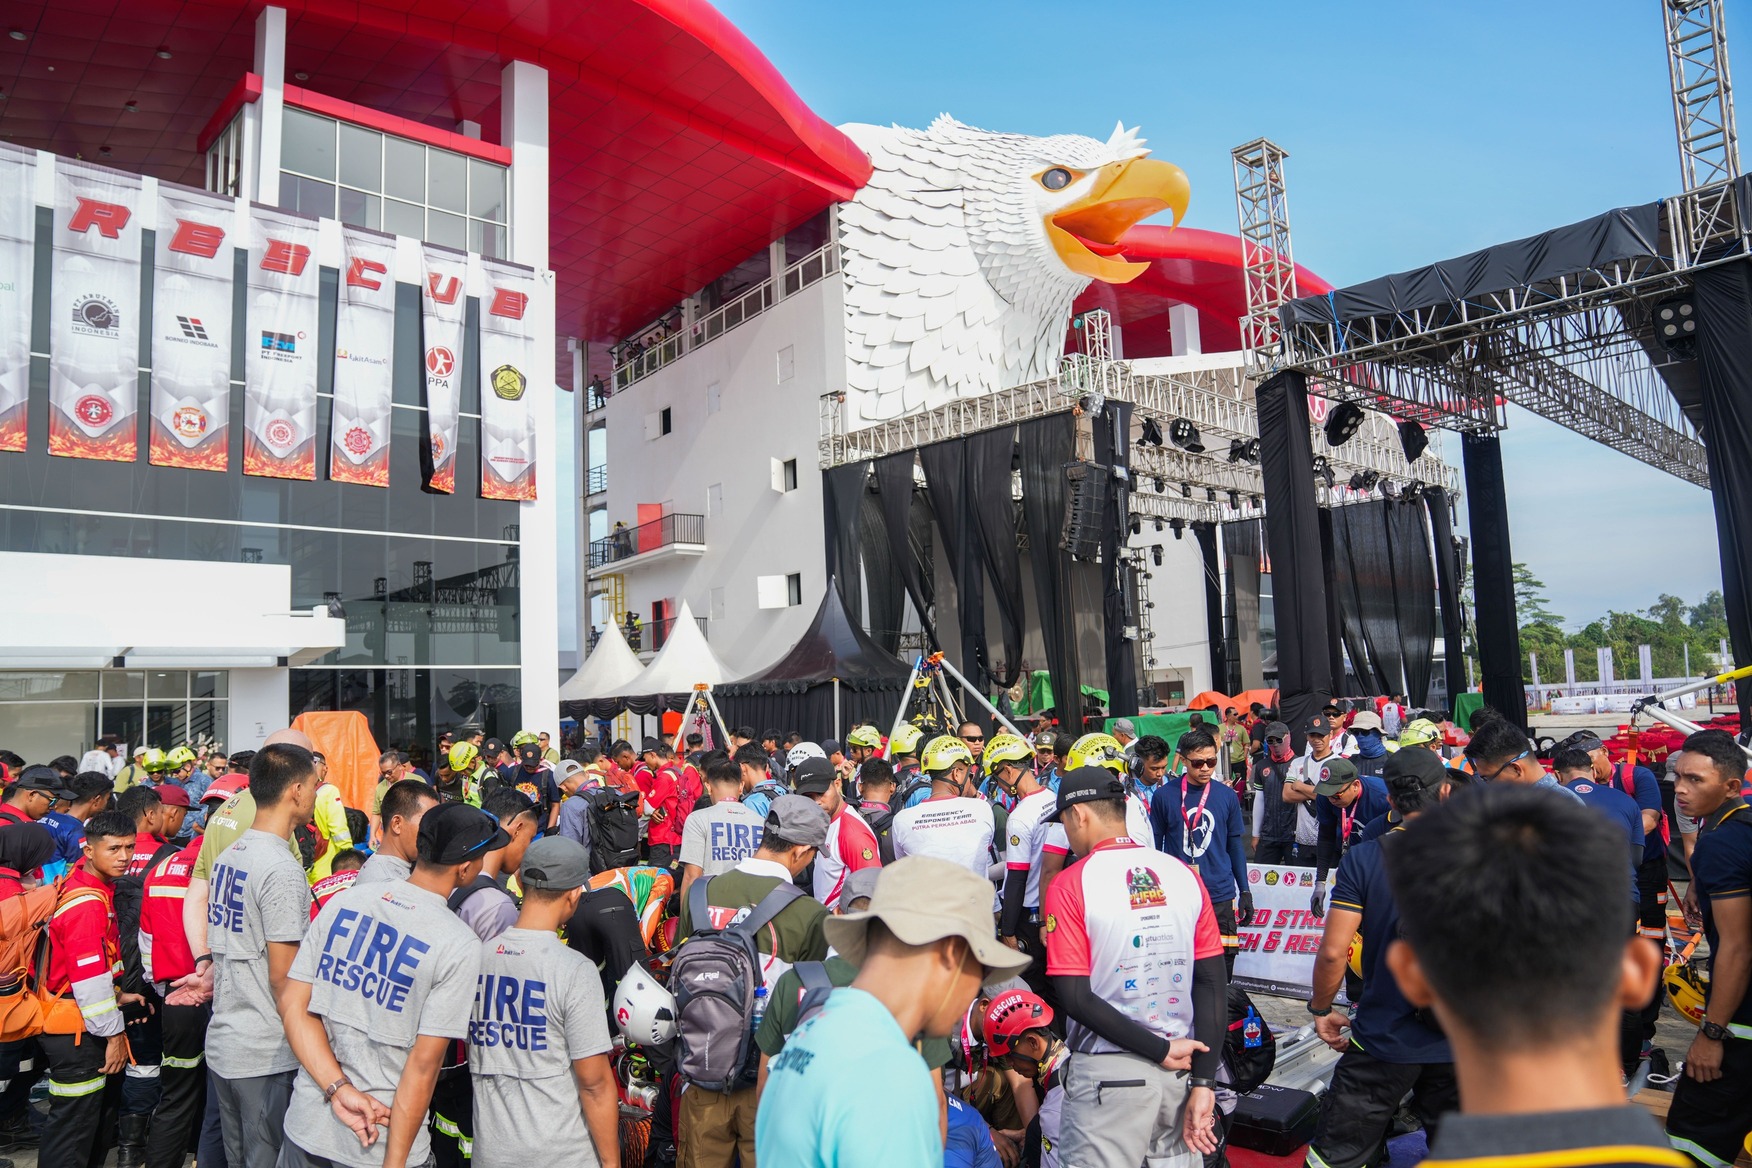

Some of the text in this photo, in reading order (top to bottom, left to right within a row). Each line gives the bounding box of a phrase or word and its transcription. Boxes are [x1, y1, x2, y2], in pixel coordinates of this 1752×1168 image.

[71, 325, 119, 337] INDONESIA
[165, 335, 219, 349] BORNEO INDOBARA
[428, 376, 449, 389] PPA
[914, 813, 972, 825] RESPONSE TEAM
[921, 809, 965, 819] EMERGENCY
[931, 821, 960, 829] PERKASA
[960, 818, 977, 826] ABADI
[711, 822, 764, 849] FIRE
[711, 846, 755, 862] RESC
[167, 864, 187, 876] FIRE
[323, 908, 431, 988] FIRE
[1263, 931, 1282, 951] &
[316, 953, 410, 1013] RESCUE
[989, 994, 1023, 1022] RESCUER
[469, 1021, 547, 1051] RESCUE
